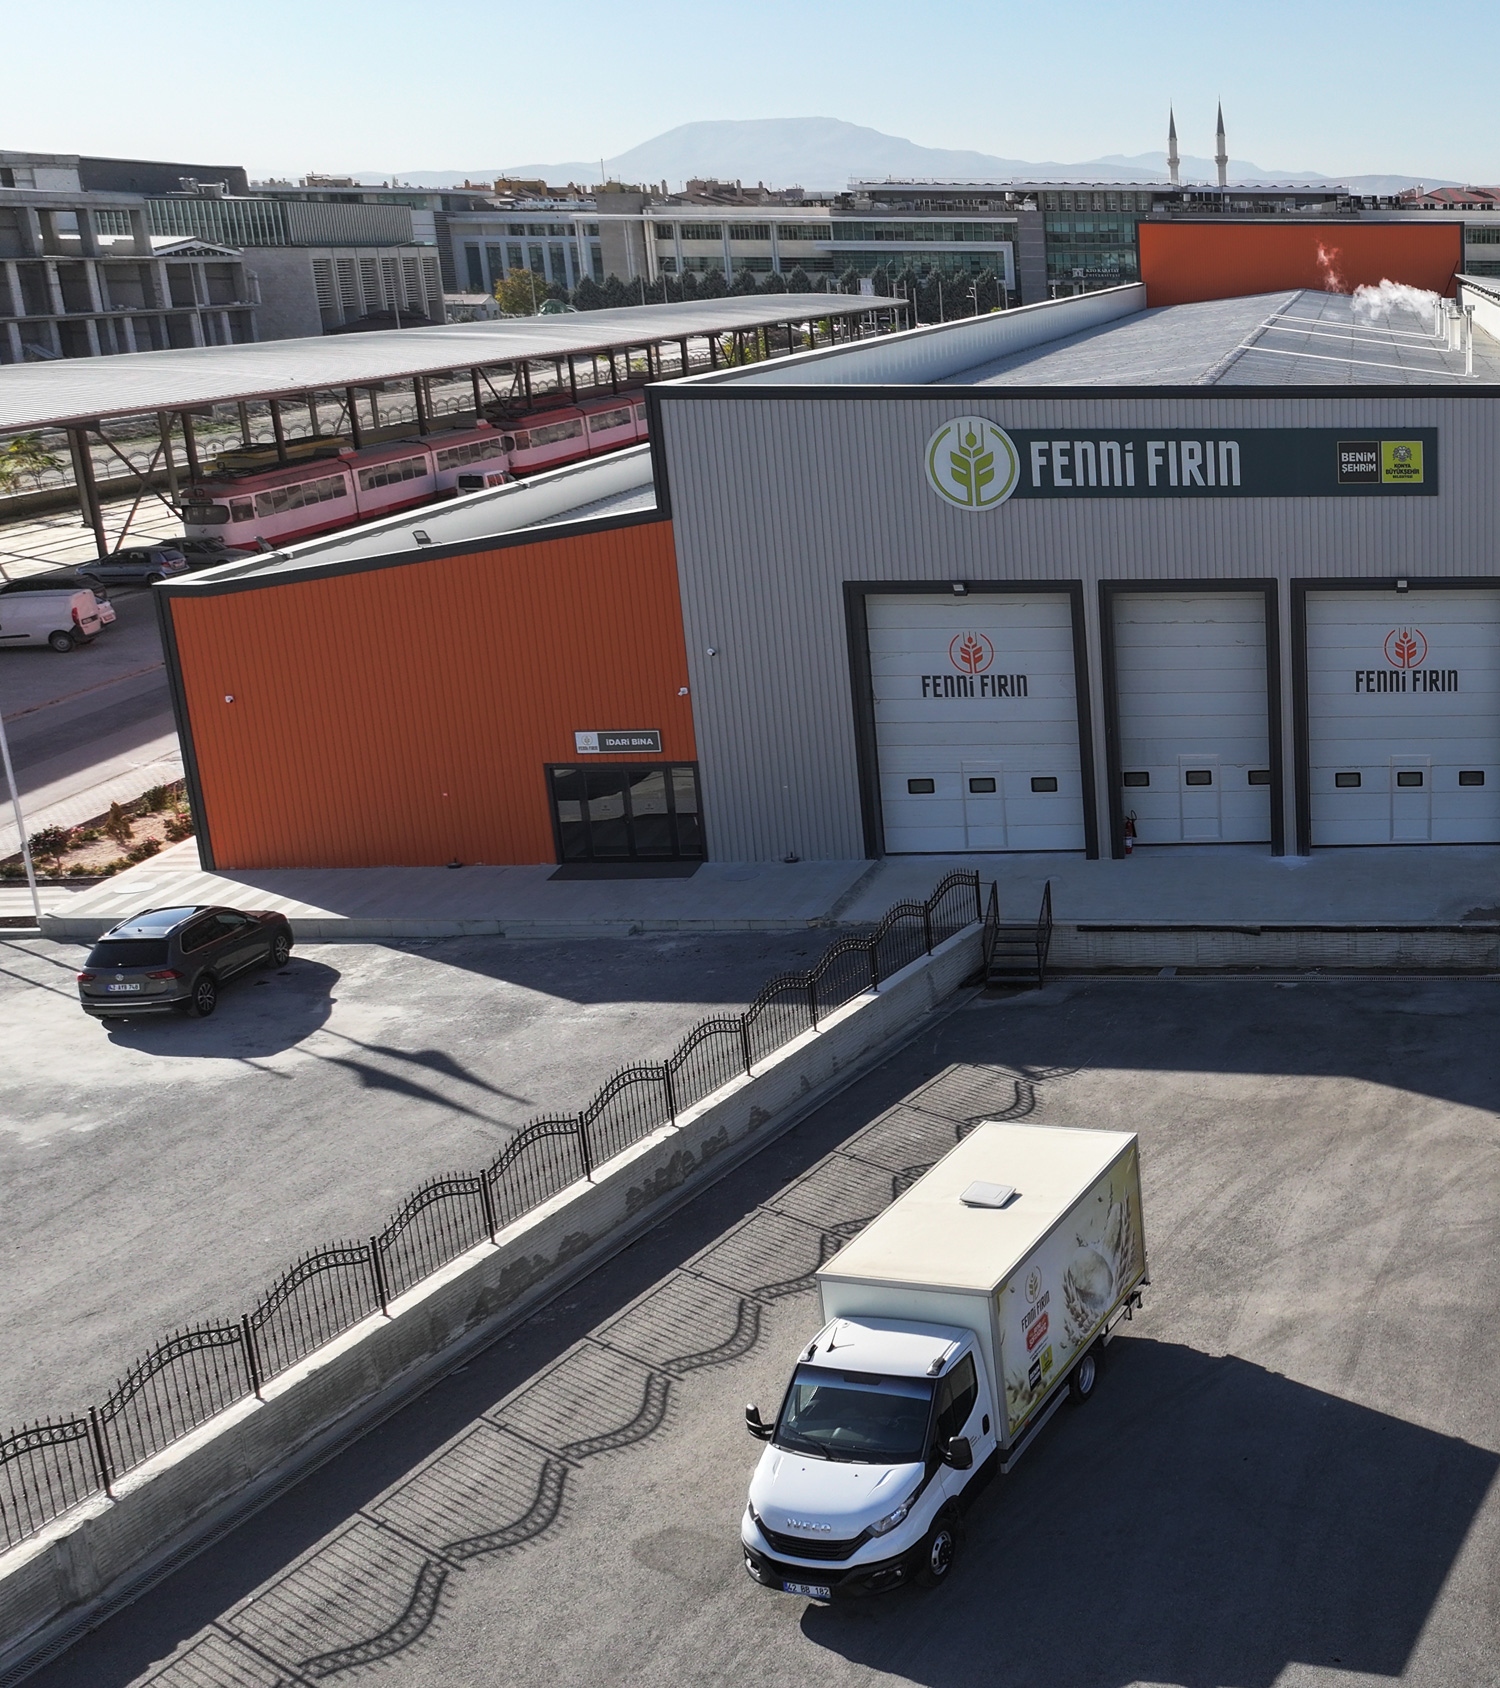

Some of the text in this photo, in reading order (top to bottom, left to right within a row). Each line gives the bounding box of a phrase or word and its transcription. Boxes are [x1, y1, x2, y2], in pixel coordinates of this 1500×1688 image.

[1147, 440, 1241, 487] FIRIN
[980, 674, 1028, 698] FIRIN
[1412, 669, 1458, 692] FIRIN
[787, 1518, 832, 1533] IVECO
[787, 1584, 797, 1592] 42
[815, 1587, 830, 1596] 182
